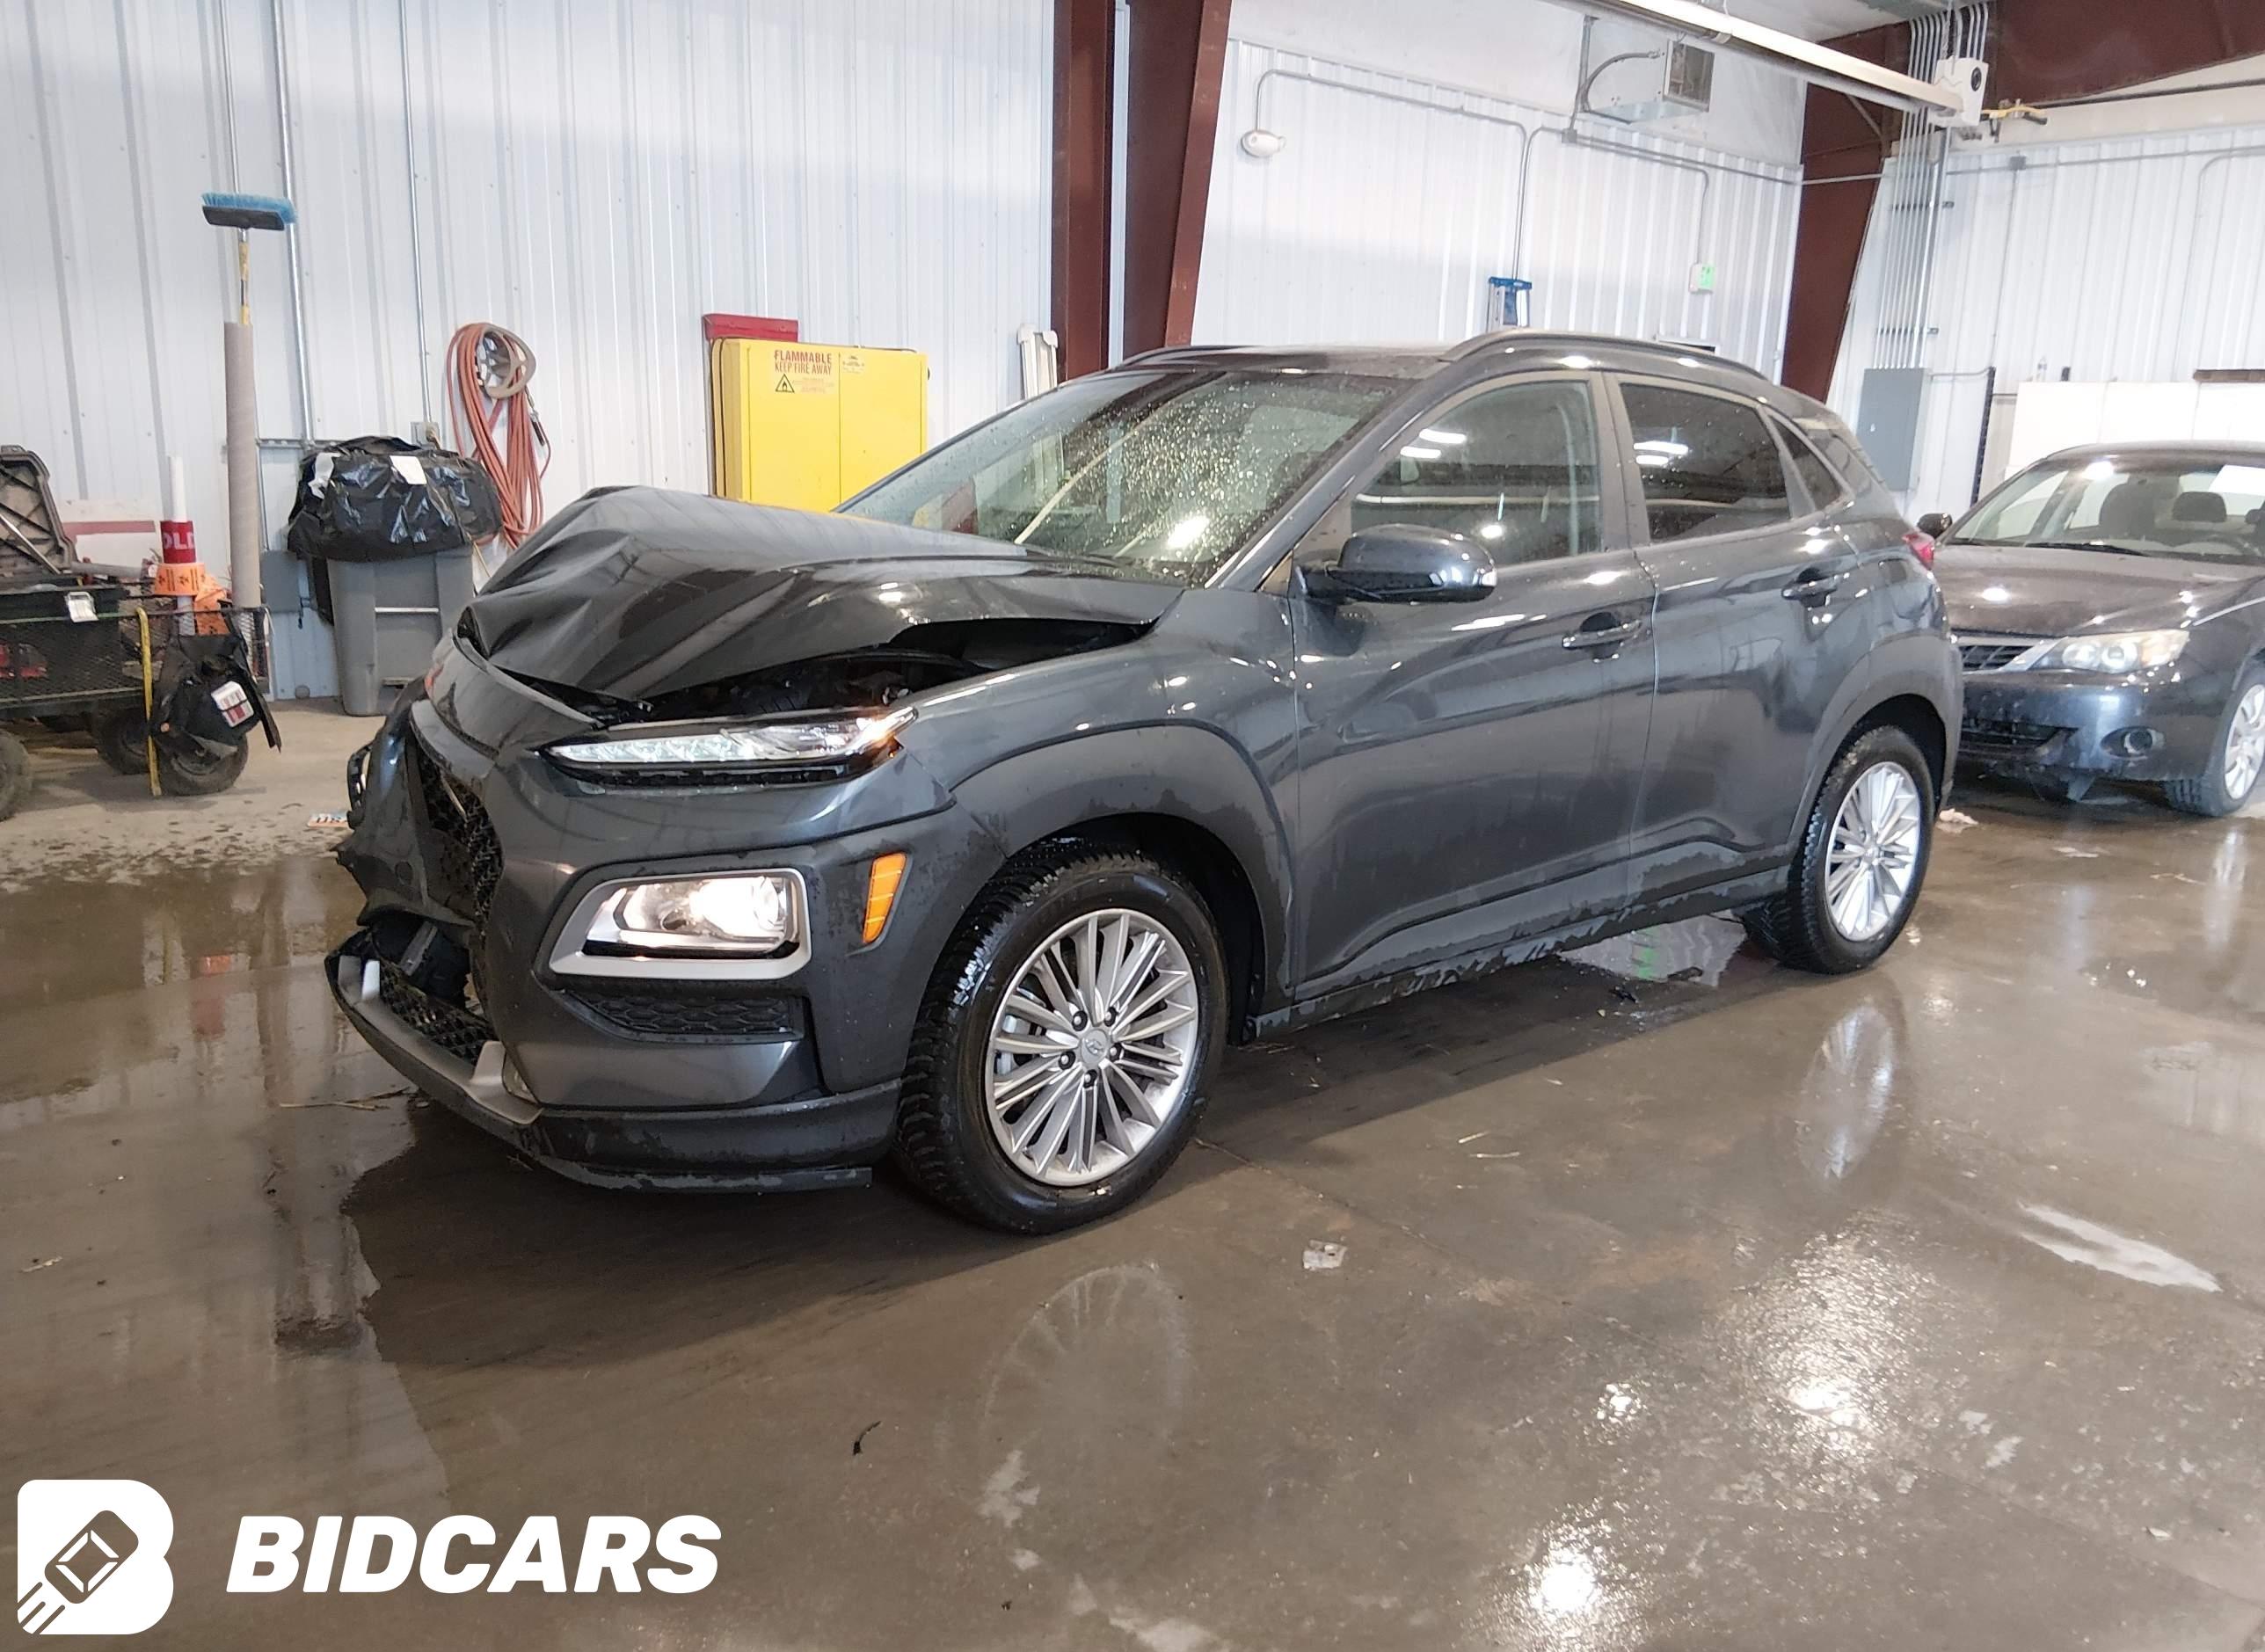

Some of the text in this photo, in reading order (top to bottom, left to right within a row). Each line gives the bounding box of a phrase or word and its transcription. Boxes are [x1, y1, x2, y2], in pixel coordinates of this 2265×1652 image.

[774, 350, 832, 364] FLAMMABLE
[775, 360, 792, 373] KEEP
[794, 361, 810, 374] FIRE
[812, 363, 832, 375] AWAY
